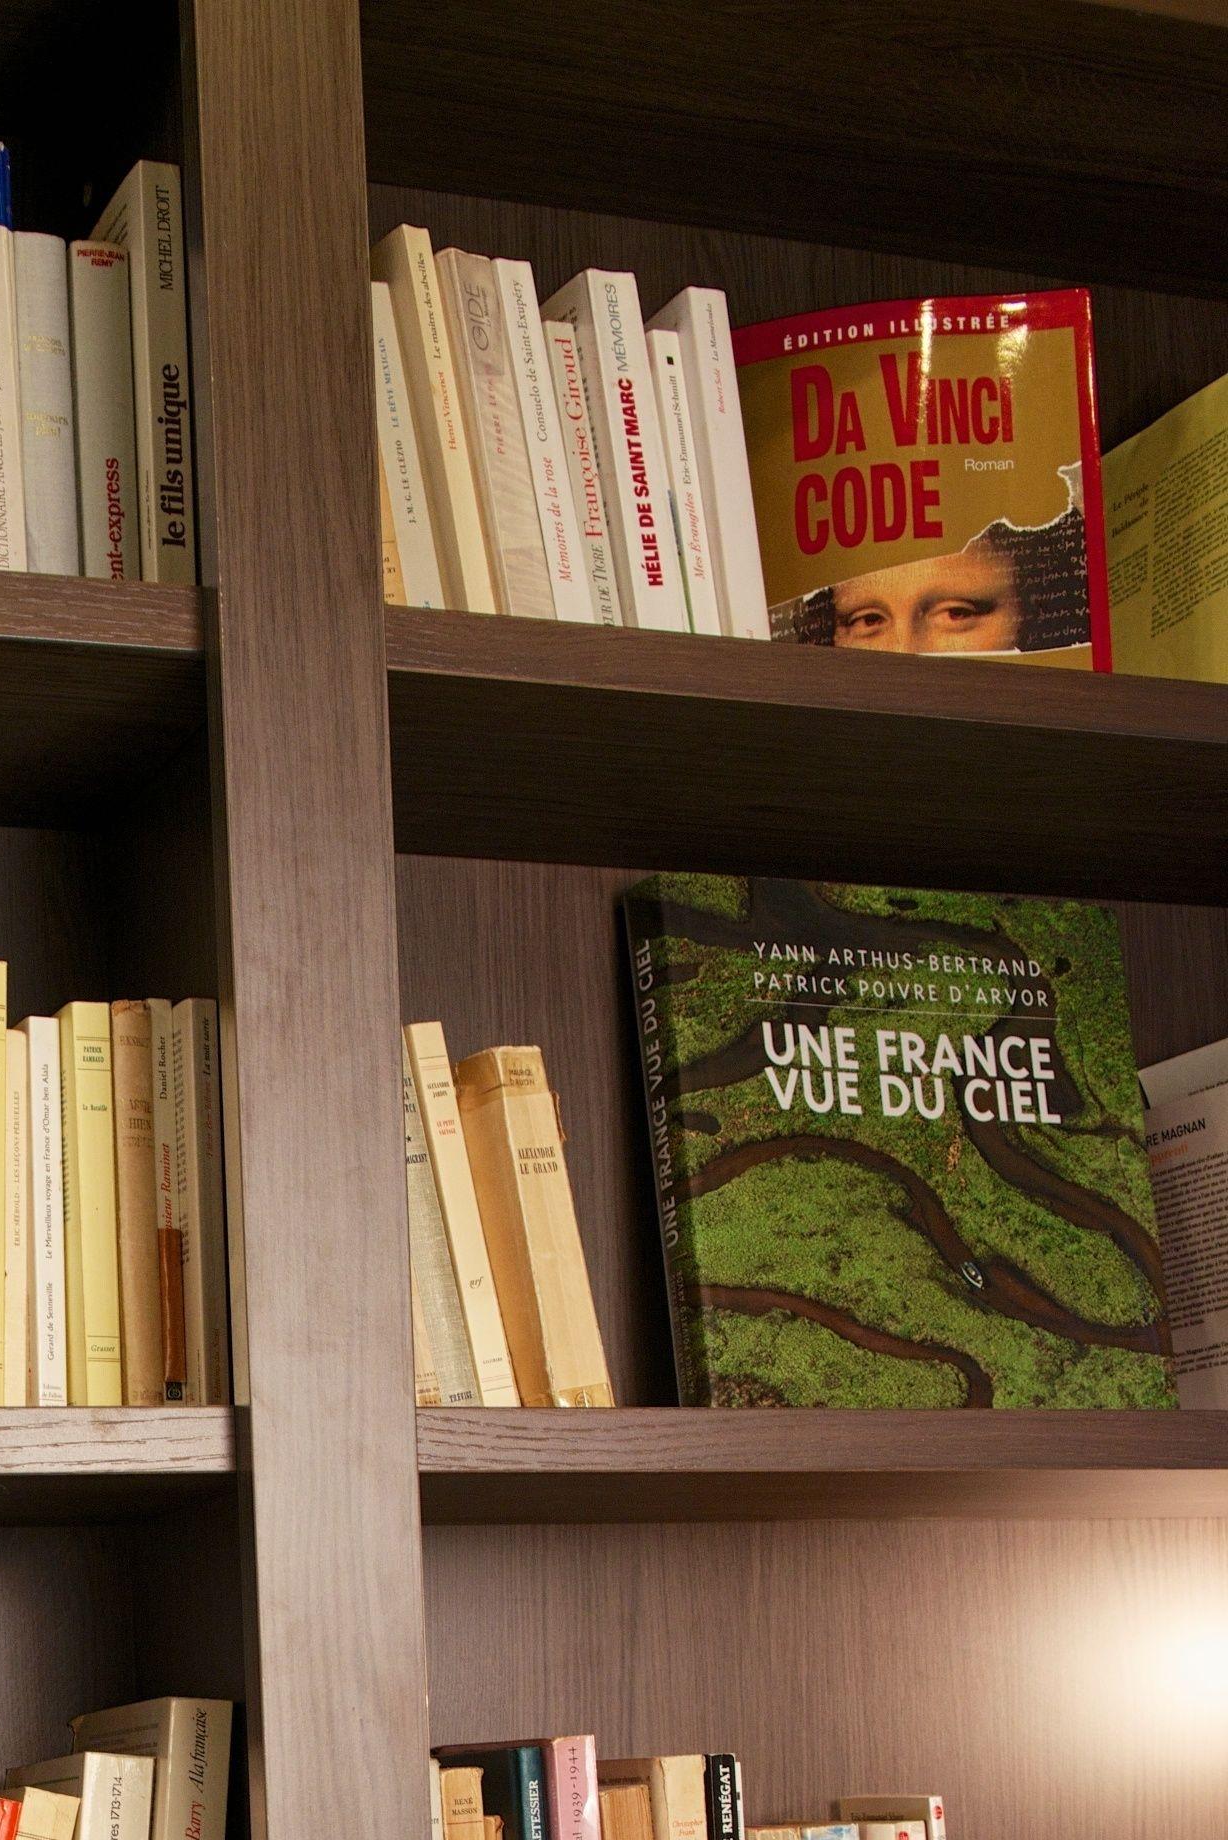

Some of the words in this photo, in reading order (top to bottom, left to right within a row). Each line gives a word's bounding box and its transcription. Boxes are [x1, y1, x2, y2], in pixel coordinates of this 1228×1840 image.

[155, 184, 171, 229] DROIT
[77, 248, 125, 263] PIERRE-JEAN
[159, 230, 175, 291] MICHEL
[417, 252, 432, 295] abeilles
[424, 296, 436, 315] des
[512, 279, 537, 366] Saint-Exupéry
[428, 317, 440, 346] maître
[605, 283, 629, 373] MÉMOIRES
[783, 323, 874, 351] ÉDITION
[889, 313, 1012, 335] ILLUSTRÉE
[433, 346, 442, 360] Le
[438, 370, 453, 418] Vincenot
[525, 368, 538, 385] de
[555, 338, 583, 421] Giroud
[670, 375, 682, 403] Schmitt
[157, 363, 188, 469] unique
[529, 385, 548, 443] Consuelo
[619, 377, 641, 437] MARC
[672, 404, 692, 486] Eric-Emmanuel
[963, 457, 1015, 472] Roman
[542, 457, 558, 483] rose
[572, 426, 604, 541] Françoise
[627, 440, 651, 498] SAINT
[160, 470, 185, 519] fils
[544, 486, 559, 498] la
[547, 501, 562, 518] de
[793, 459, 944, 556] CODE
[161, 521, 187, 550] le
[638, 502, 655, 529] DE
[684, 491, 702, 554] Évangiles
[554, 520, 573, 584] Mémoires
[641, 532, 664, 588] HÉLIE
[692, 558, 706, 580] Mes
[635, 937, 656, 993] CIEL
[752, 941, 818, 966] YANN
[828, 946, 1042, 979] ARTHUS-BERTRAND
[753, 971, 849, 996] PATRICK
[859, 977, 939, 1003] POIVRE
[949, 984, 1050, 1009] D'ARVOR
[641, 998, 660, 1034] DU
[159, 1034, 168, 1072] Rocher
[645, 1037, 667, 1093] VUE
[761, 1019, 861, 1072] UNE
[875, 1028, 1057, 1081] FRANCE
[158, 1073, 168, 1101] Daniel
[764, 1064, 863, 1116] VUE
[879, 1073, 947, 1121] DU
[963, 1078, 1063, 1125] CIEL
[648, 1094, 673, 1193] FRANCE
[1161, 1117, 1207, 1143] MAGNAN
[517, 1145, 556, 1161] ALEXANDRE
[519, 1164, 530, 1175] LE
[533, 1162, 559, 1174] GRAND
[90, 1343, 116, 1354] Grasset
[112, 1776, 124, 1822] 1713-1714
[451, 1806, 479, 1817] MASSON
[717, 1764, 733, 1834] RENÉGAT
